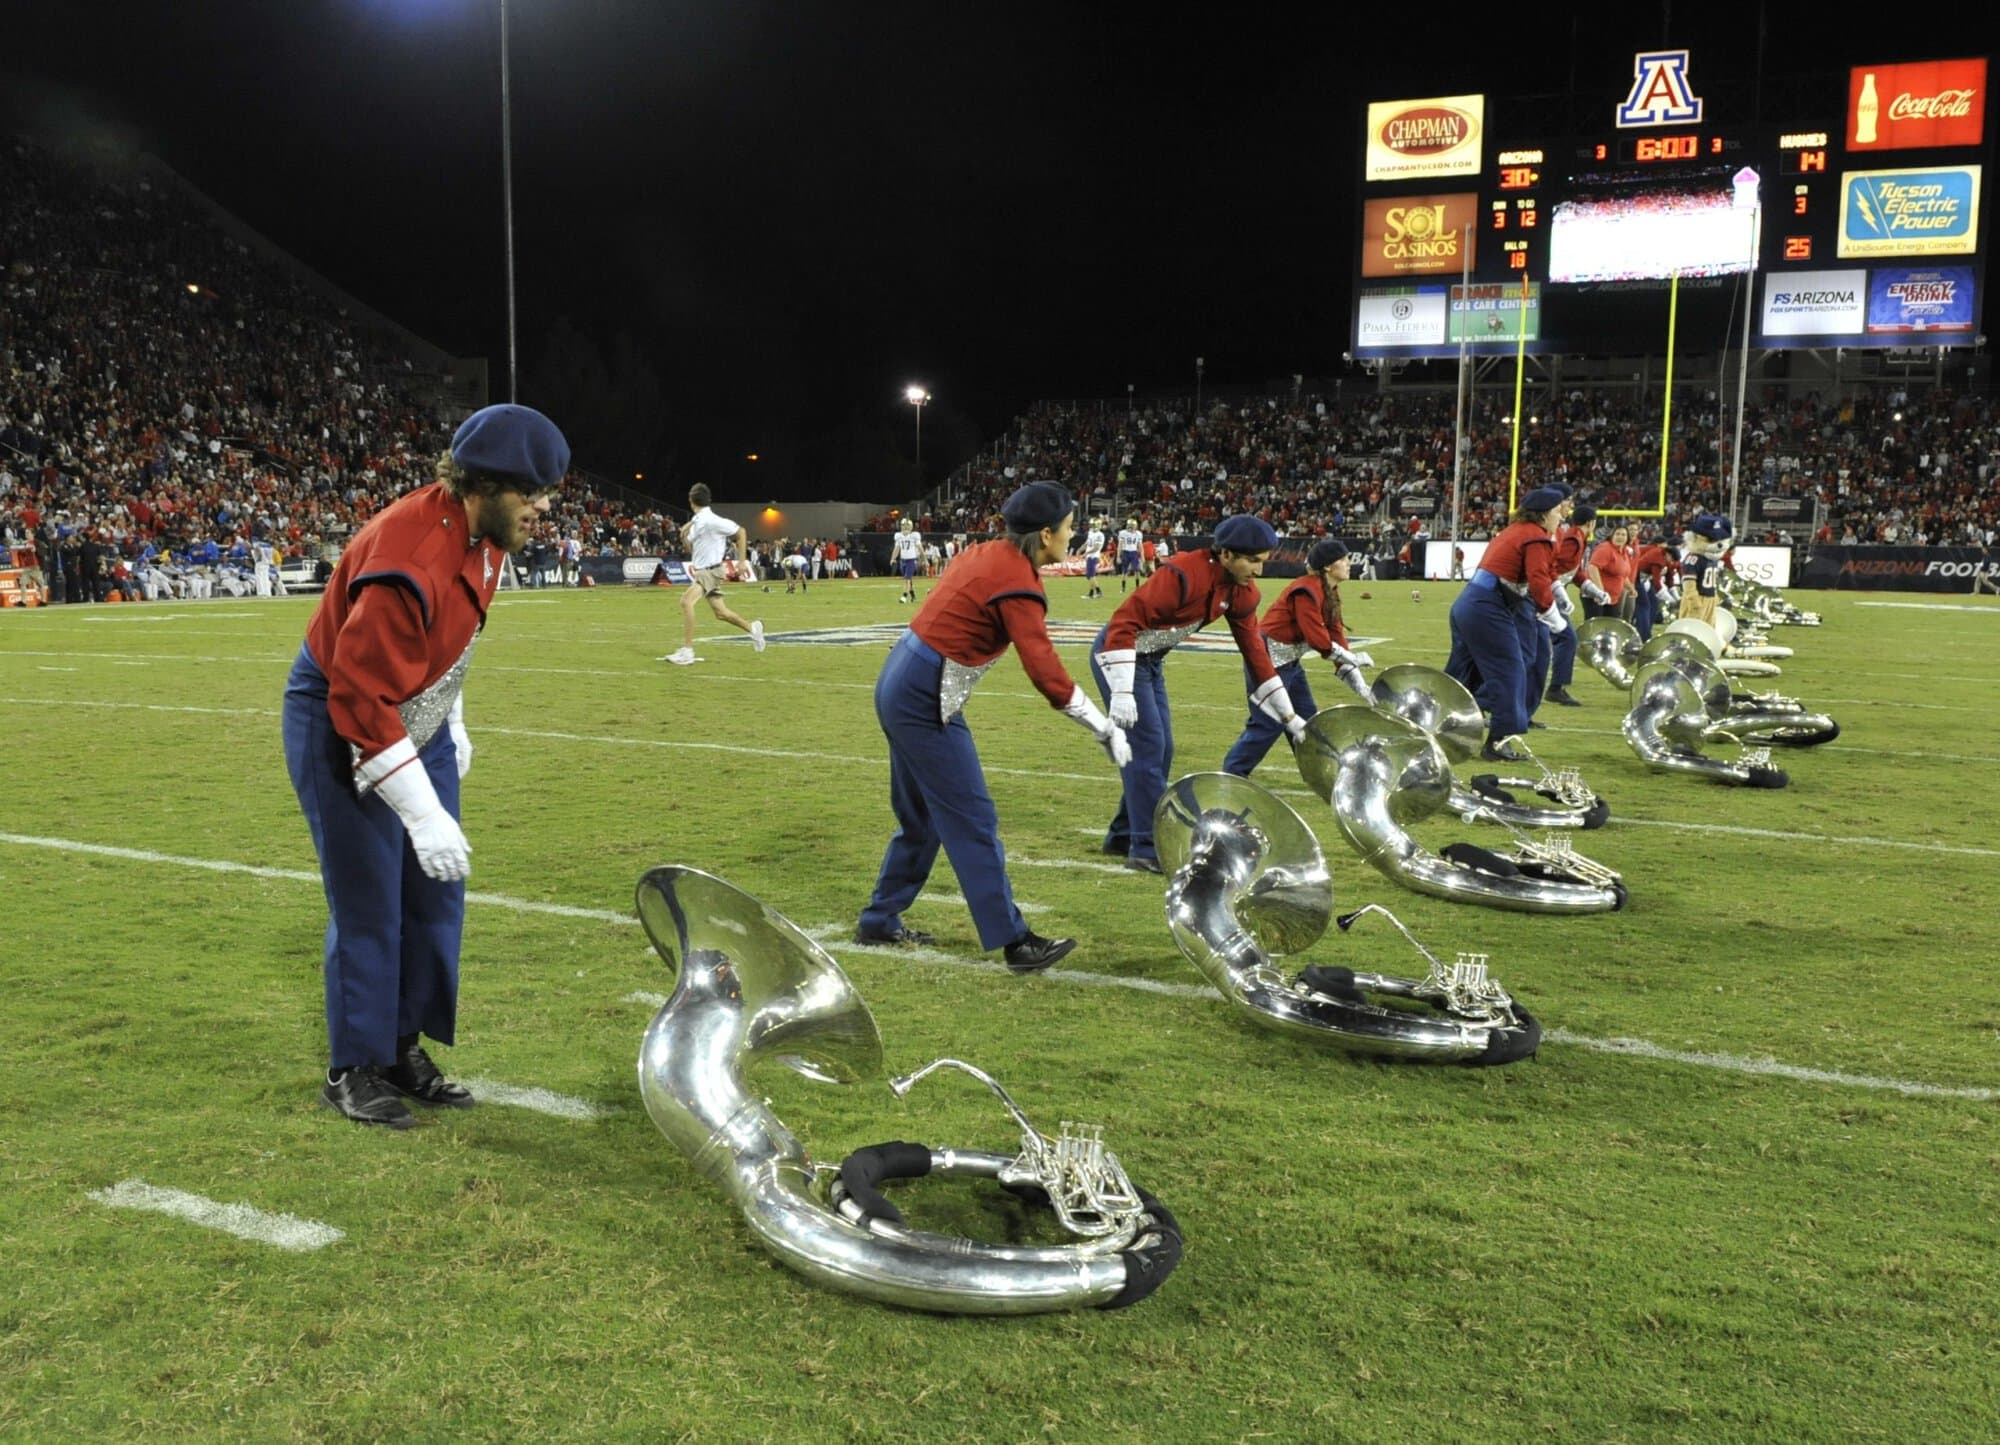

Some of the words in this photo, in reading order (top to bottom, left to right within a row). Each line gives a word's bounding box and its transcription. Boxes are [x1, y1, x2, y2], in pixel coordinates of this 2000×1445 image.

[1616, 49, 1703, 128] A
[1888, 88, 1976, 121] Coca-Cola
[1388, 116, 1460, 140] CHAPMAN
[1390, 136, 1459, 149] AUTOMOTIVE
[1635, 136, 1698, 161] 6:00
[1711, 138, 1722, 153] 3
[1596, 144, 1606, 160] 3
[1800, 151, 1826, 172] 14
[1500, 168, 1531, 189] 30
[1877, 182, 1943, 199] Tucson
[1794, 196, 1807, 215] 3
[1884, 196, 1961, 214] Electric
[1383, 205, 1457, 243] SOL
[1493, 211, 1506, 230] 3
[1519, 210, 1537, 228] 12
[1889, 214, 1959, 231] Power
[1383, 240, 1457, 259] CASINOS
[1785, 237, 1812, 258] 25
[1510, 252, 1527, 269] 18
[1792, 291, 1855, 305] ARIZONA
[1889, 283, 1952, 296] ENERGY
[1904, 292, 1952, 303] DRINK
[1473, 301, 1498, 310] CARE
[1498, 299, 1537, 310] CENTRS
[1363, 322, 1392, 334] PIMA
[901, 541, 911, 550] 17
[1840, 560, 1926, 575] ARIZONA
